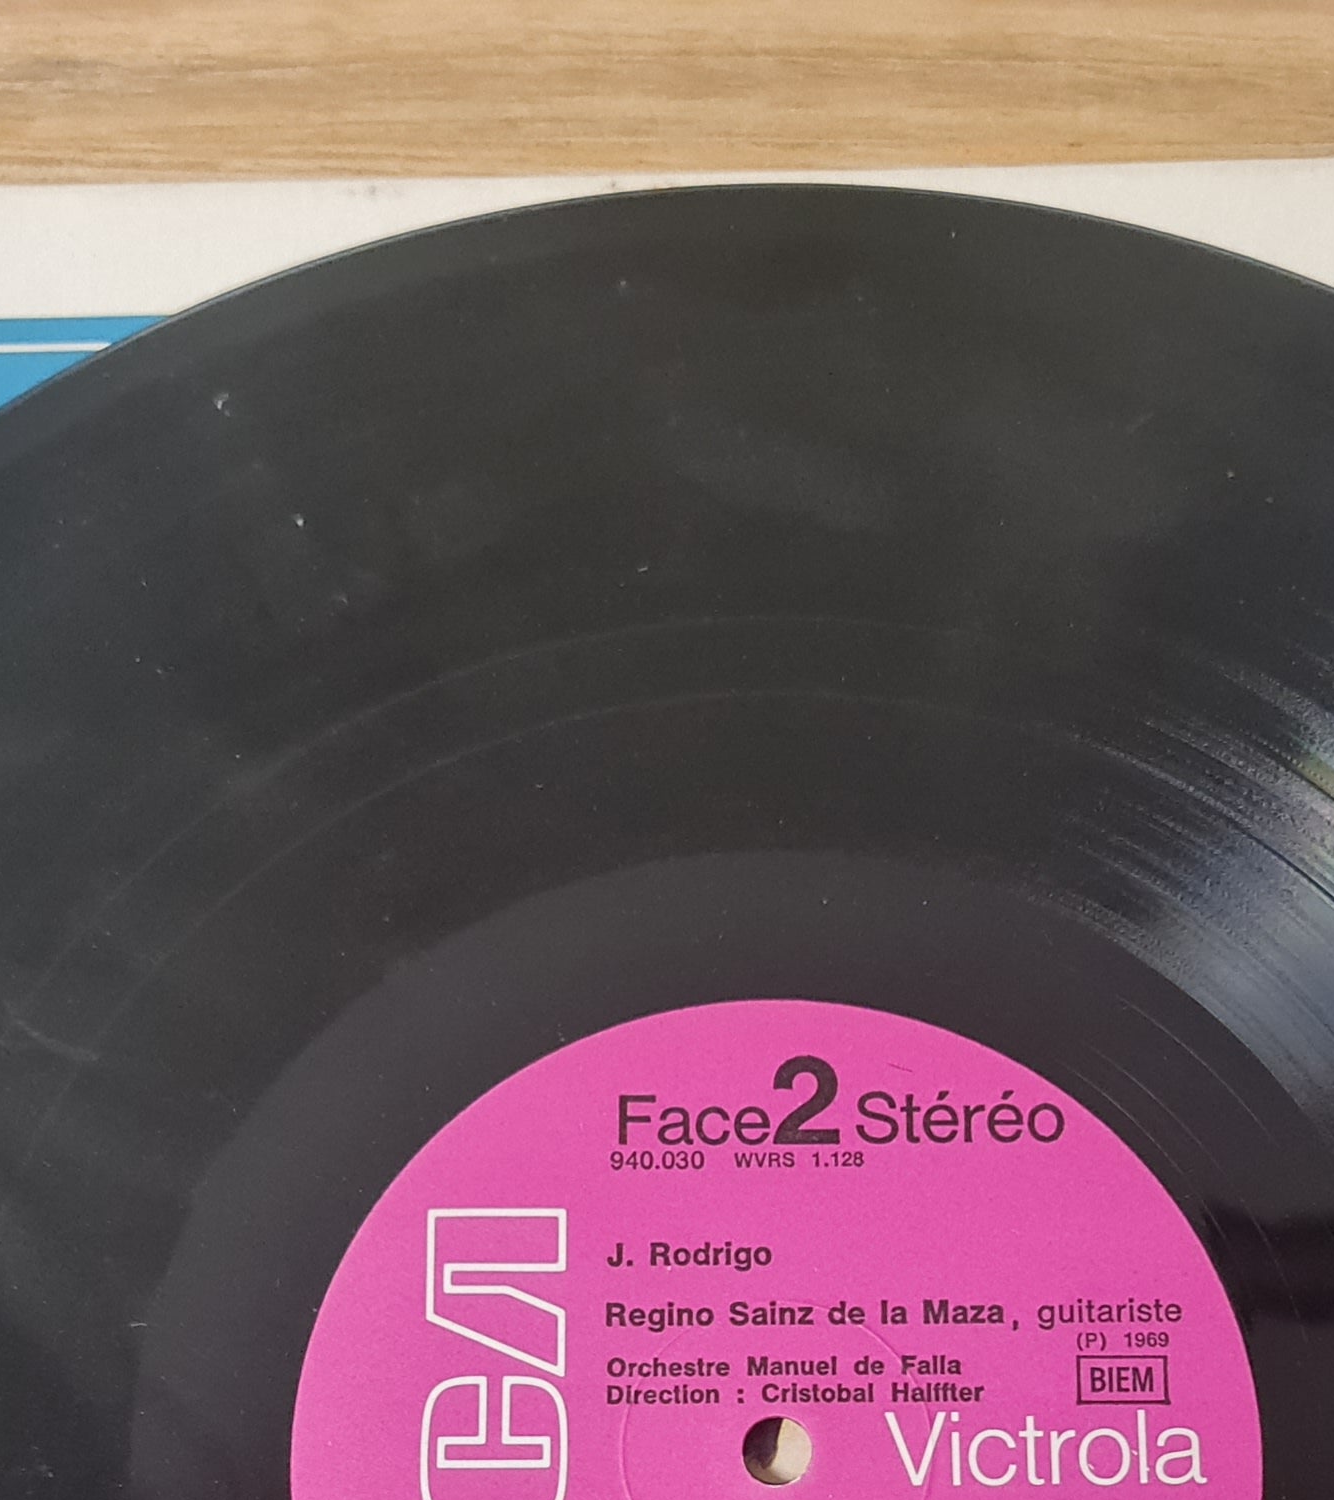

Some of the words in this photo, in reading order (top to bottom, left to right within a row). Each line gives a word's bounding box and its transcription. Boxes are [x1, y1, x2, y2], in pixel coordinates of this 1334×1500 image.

[618, 1094, 771, 1146] Face
[772, 1054, 841, 1145] 2
[855, 1089, 1066, 1145] Stéréo
[609, 1150, 705, 1171] 940.030
[733, 1151, 795, 1169] WVRS
[811, 1151, 865, 1168] 1.128
[606, 1242, 634, 1268] J.
[649, 1241, 772, 1272] Rodrigo
[605, 1301, 715, 1333] Regino
[728, 1300, 815, 1326] Sainz
[827, 1300, 866, 1326] de
[880, 1299, 908, 1325] la
[1037, 1297, 1182, 1331] guitariste
[1076, 1331, 1107, 1352] (P)
[1123, 1331, 1170, 1348] 1969
[606, 1357, 730, 1378] Orchestre
[747, 1355, 838, 1377] Manuel
[853, 1355, 885, 1376] de
[900, 1354, 962, 1376] Falla
[1089, 1366, 1154, 1393] BIEM
[606, 1383, 720, 1405] Direction
[761, 1382, 875, 1404] Cristobal
[891, 1381, 985, 1403] Halffter
[884, 1409, 1208, 1486] Victrola
